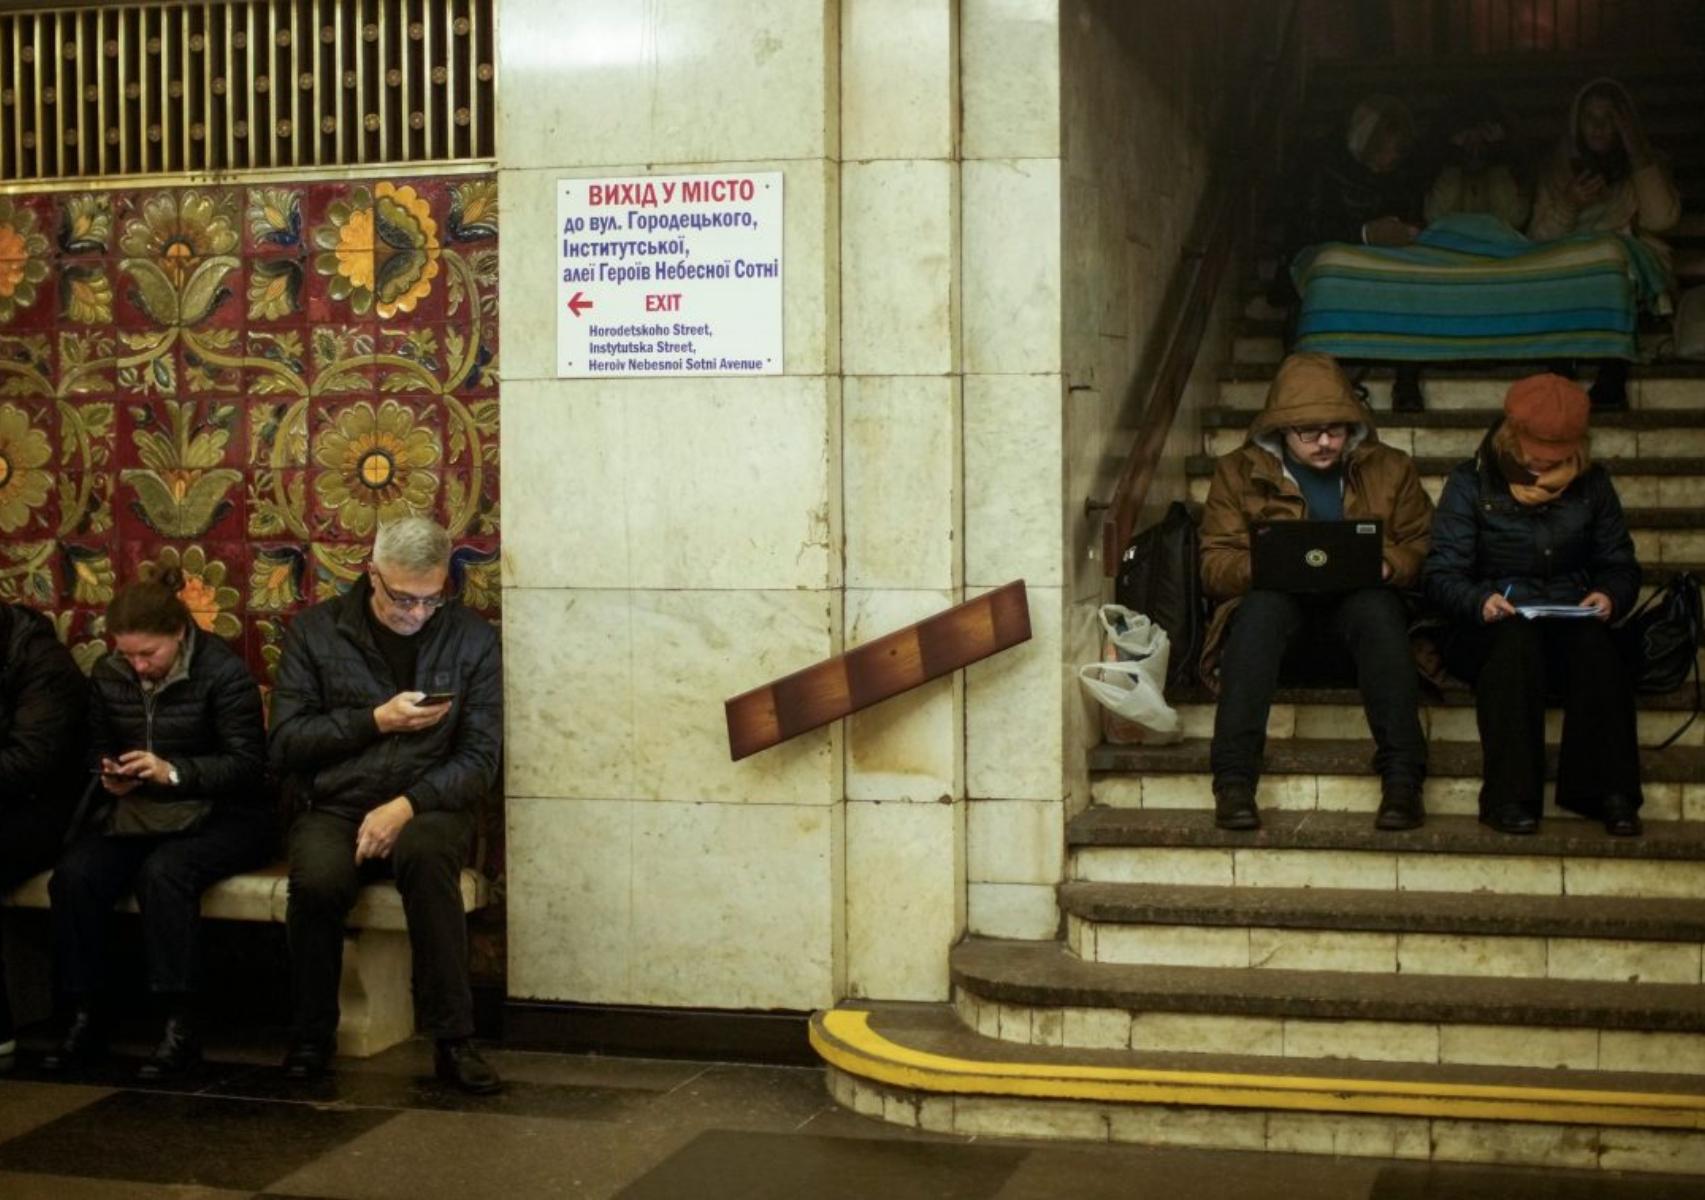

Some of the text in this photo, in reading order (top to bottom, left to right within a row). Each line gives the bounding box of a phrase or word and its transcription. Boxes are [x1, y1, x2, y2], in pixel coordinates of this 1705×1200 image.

[589, 179, 754, 207] ВИХІД У МІСТО
[564, 211, 757, 234] до вул. Городецького,
[564, 236, 690, 260] Інститутської,
[564, 259, 778, 284] алеї Героїв Небесної Сотні
[646, 294, 682, 312] EXIT
[590, 323, 712, 336] Horodetskoho Street,
[590, 341, 696, 356] Instytutska Street,
[589, 357, 762, 371] Heroiv Nebesnoi Sotni Avenue
